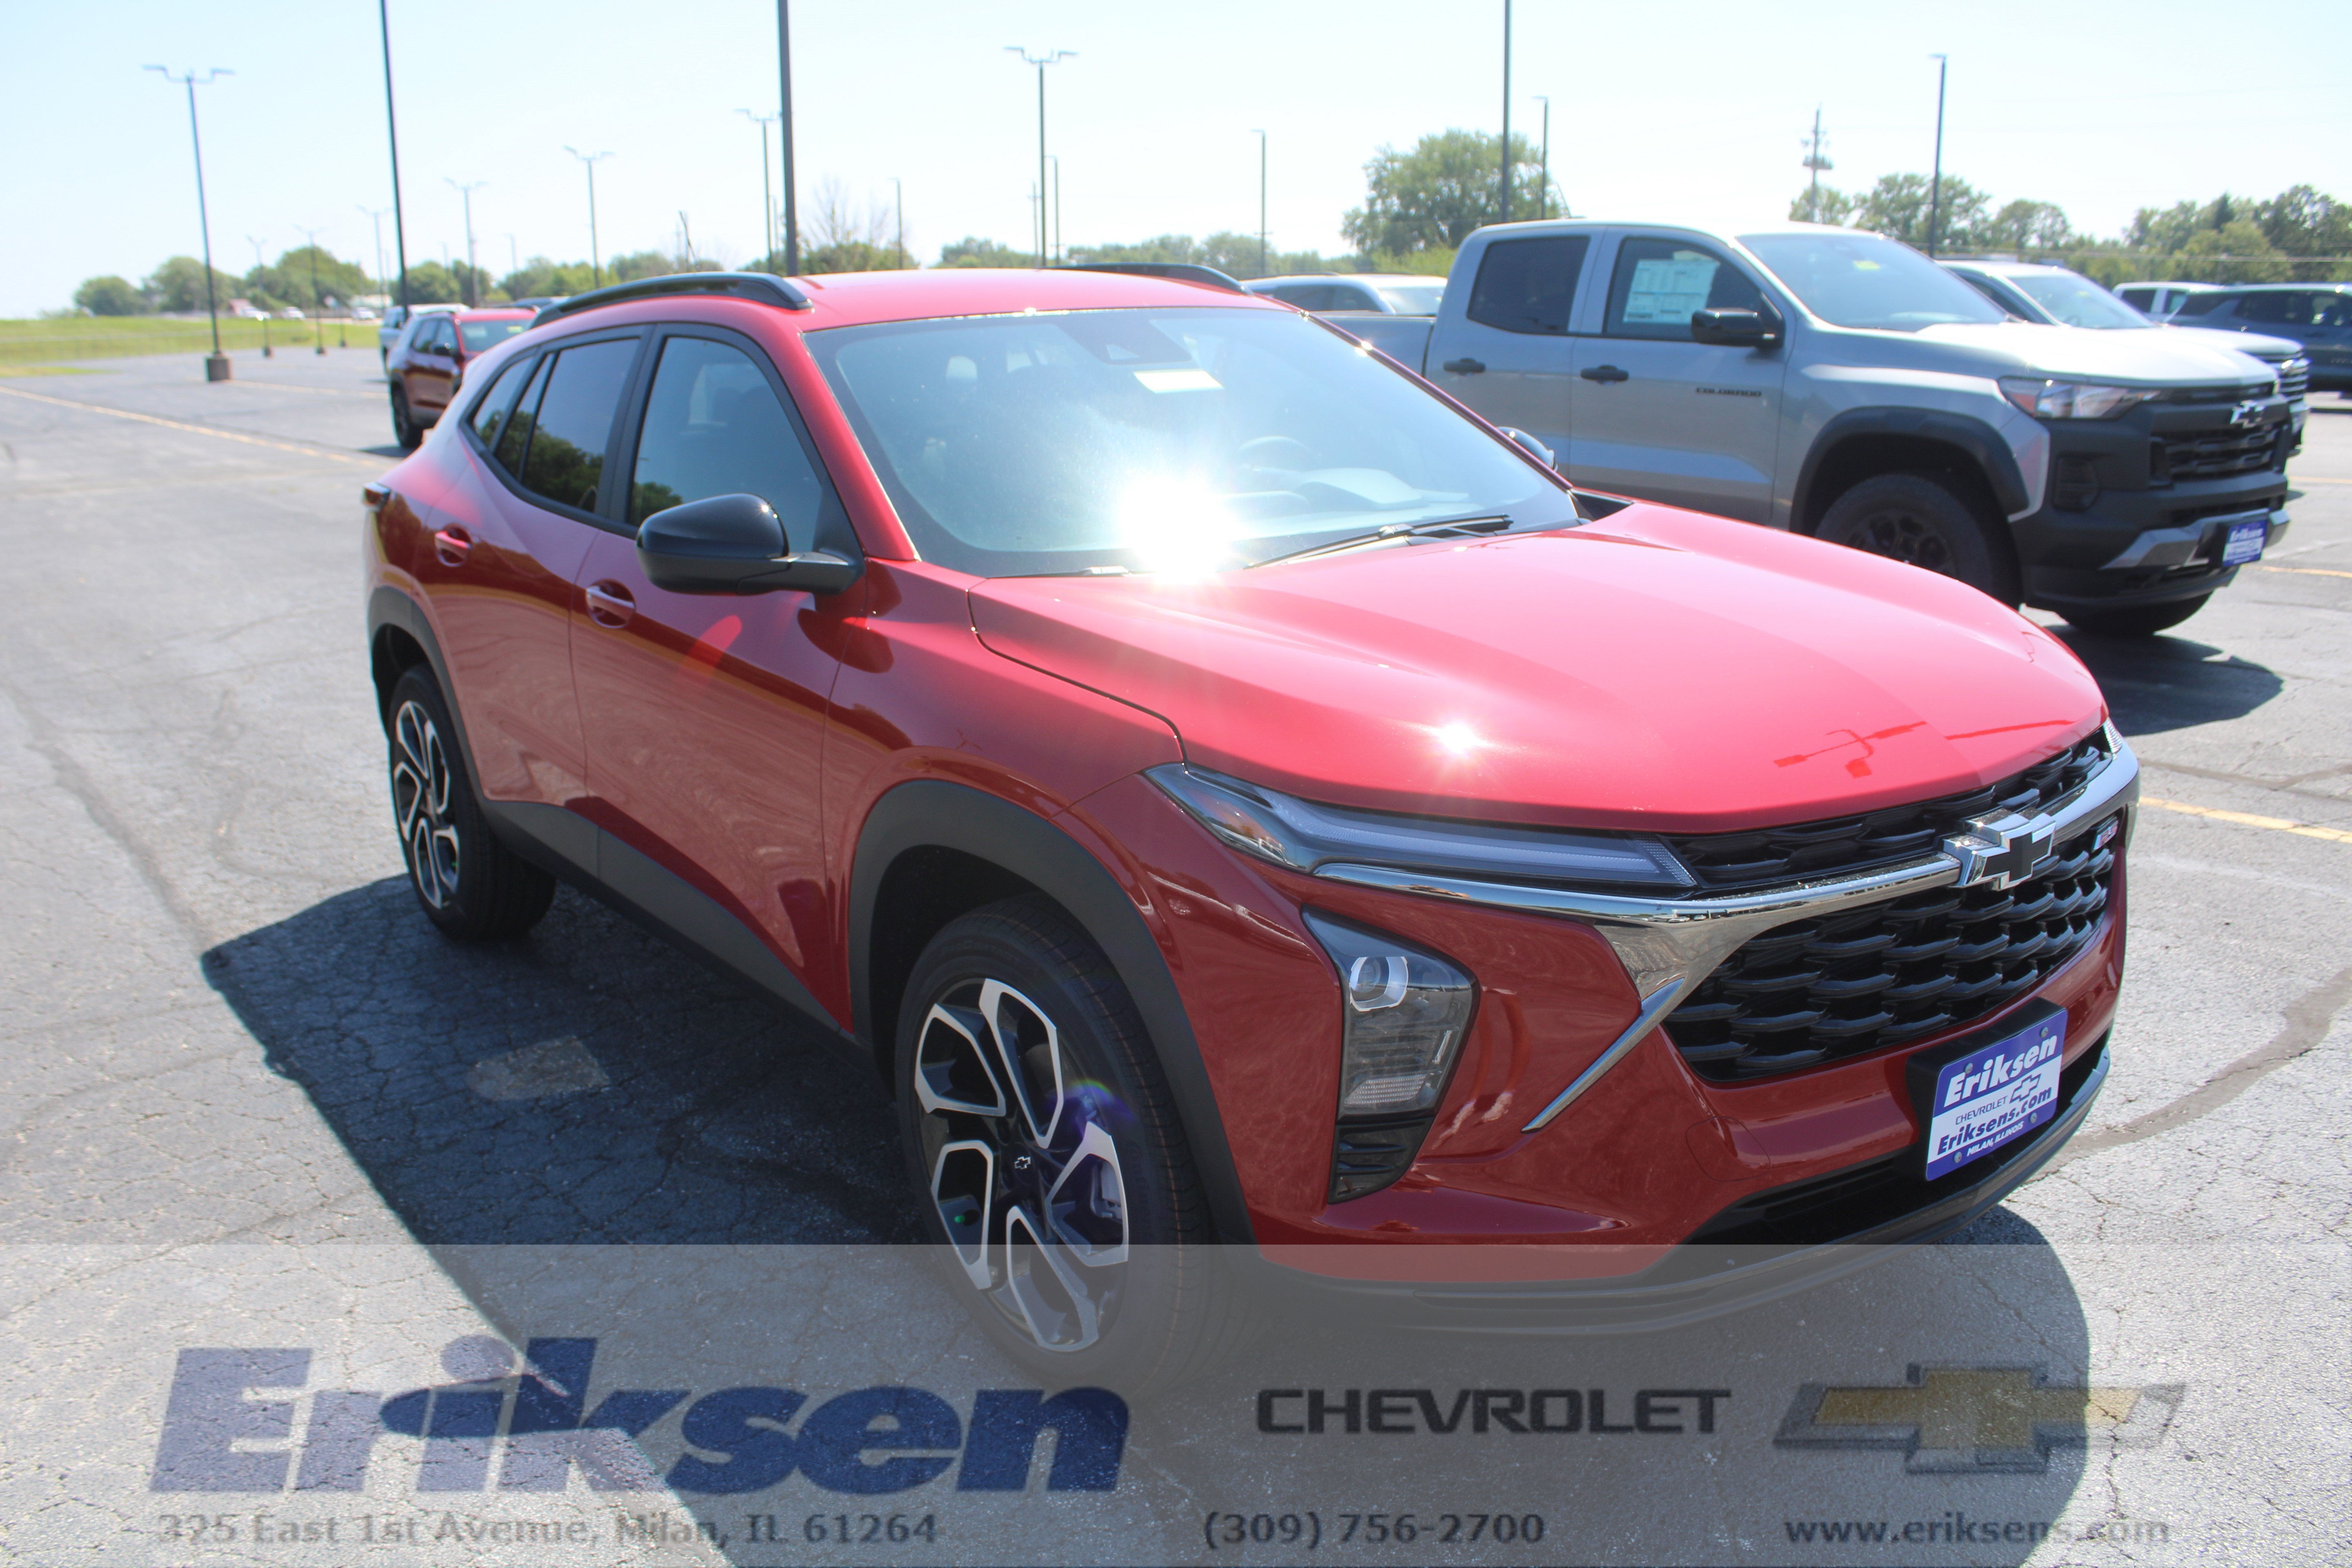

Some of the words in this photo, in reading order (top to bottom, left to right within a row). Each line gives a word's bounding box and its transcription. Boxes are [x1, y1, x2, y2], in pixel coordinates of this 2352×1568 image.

[1944, 1035, 2058, 1108] Eriksen
[1937, 1087, 2052, 1156] Eriksens.com
[1956, 1096, 2007, 1125] CHEVROLET
[1967, 1139, 1994, 1157] MILAN,
[1994, 1121, 2024, 1143] ILLINOIS
